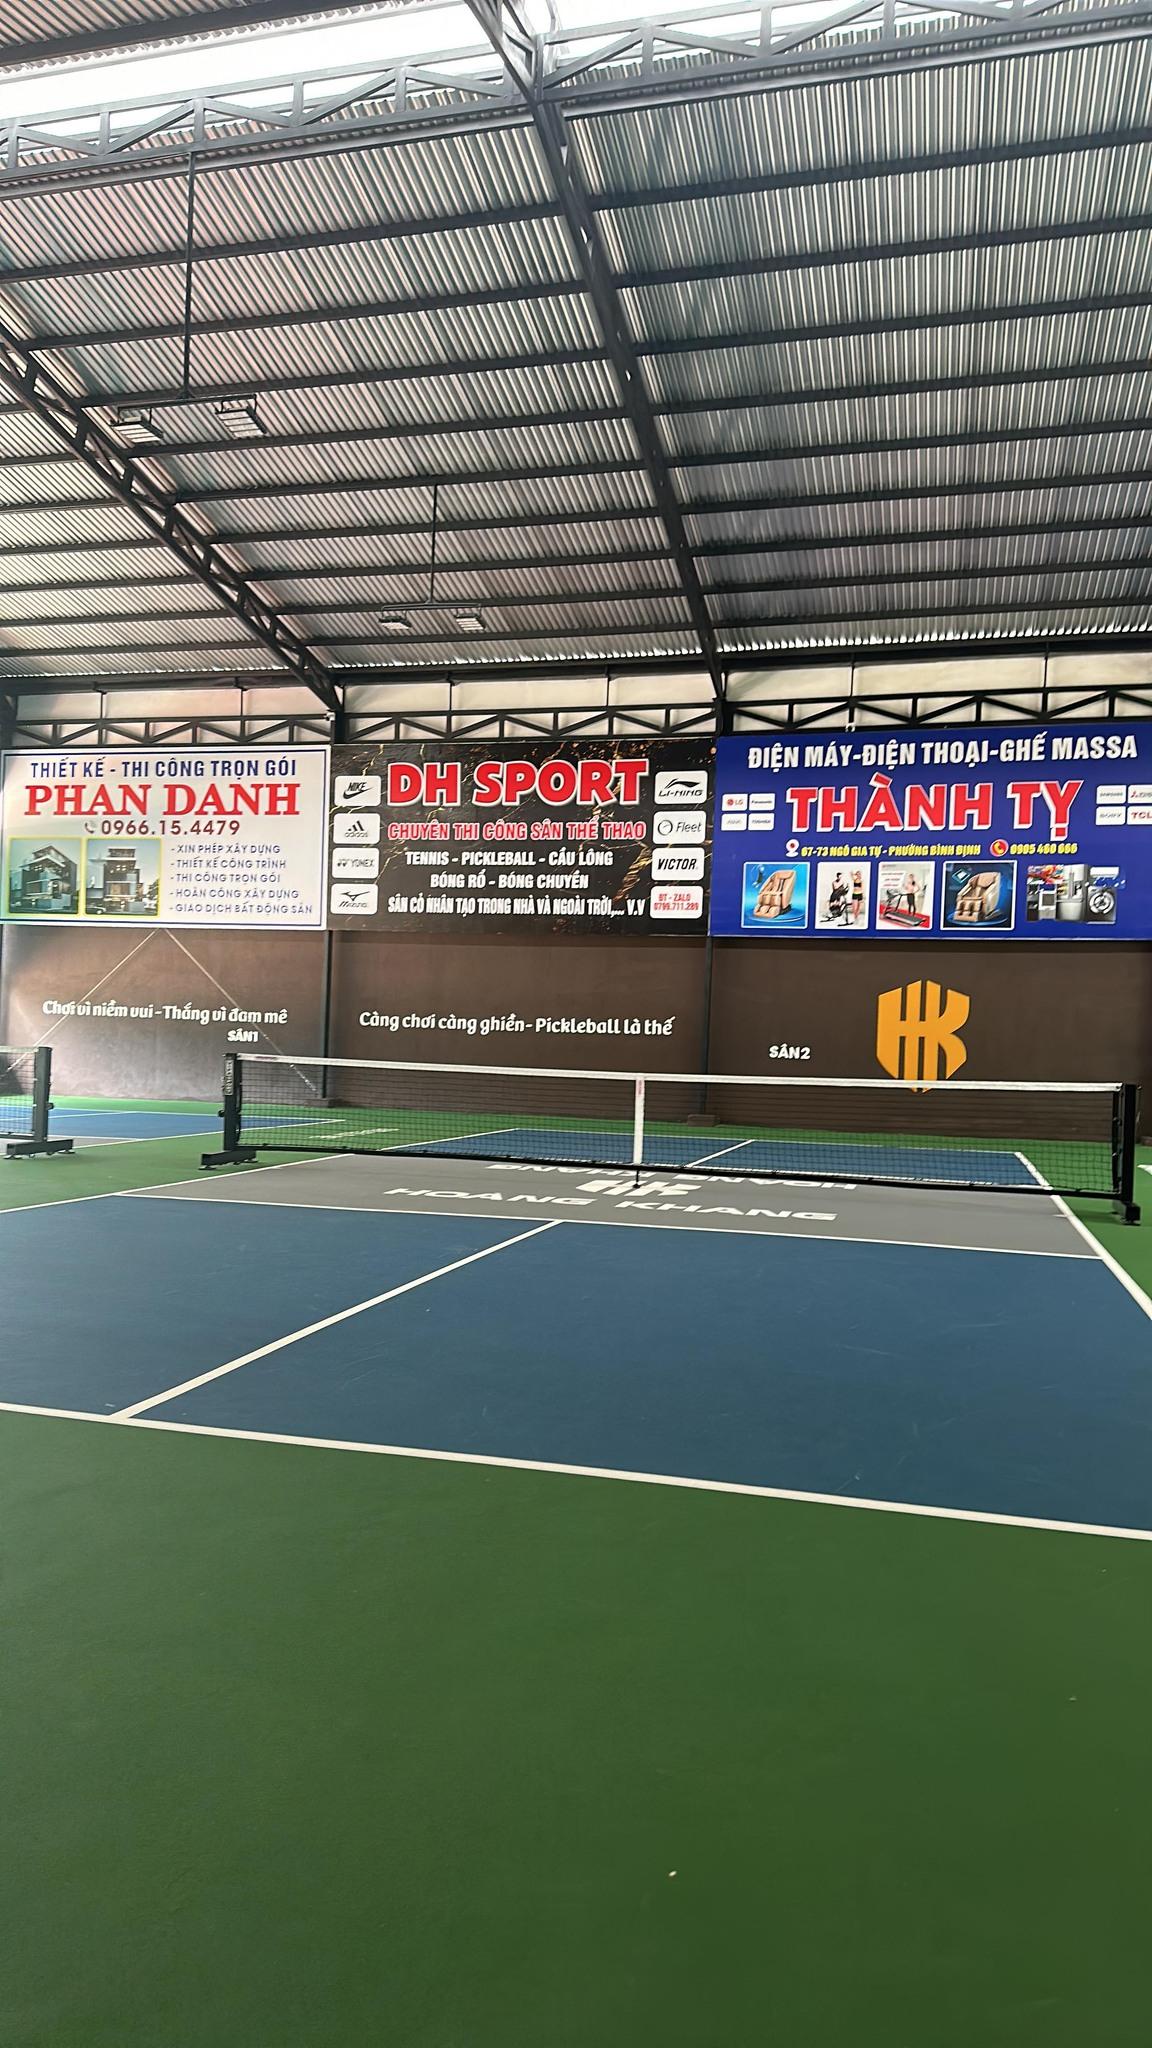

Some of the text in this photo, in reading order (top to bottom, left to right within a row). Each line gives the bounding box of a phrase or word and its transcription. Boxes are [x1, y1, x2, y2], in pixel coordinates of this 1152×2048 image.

[748, 742, 799, 772] ĐIỆN
[1051, 735, 1138, 760] MASSA
[31, 757, 77, 777] THIẾT
[84, 757, 106, 777] KẾ
[122, 761, 149, 777] THI
[155, 757, 204, 777] CÔNG
[211, 760, 258, 780] TRỌN
[266, 756, 296, 776] GÓI
[347, 782, 367, 791] NIKE
[387, 759, 649, 806] DH SPORT
[24, 783, 300, 815] PHAN DANH
[786, 771, 1084, 841] THÀNH TỴ
[102, 820, 240, 835] 0966.15.4479
[387, 819, 450, 840] CHUYÊN
[453, 823, 480, 840] THI
[483, 819, 527, 840] CÔNG
[530, 818, 563, 840] SÂN
[601, 821, 646, 840] THAO
[676, 822, 702, 833] Fleet
[177, 845, 195, 853] XIN
[405, 851, 449, 865] TENNIS
[461, 851, 536, 866] PICKLEBALL
[578, 848, 614, 866] LÔNG
[657, 858, 697, 870] VICTOR
[430, 871, 465, 888] BÓNG
[498, 871, 534, 888] BÓNG
[388, 893, 408, 913] SÂN
[409, 892, 425, 913] CỎ
[426, 894, 454, 913] NHÂN
[455, 897, 475, 918] TẠO
[477, 897, 511, 914] TRONG
[513, 894, 535, 915] NHÀ
[537, 894, 551, 915] VÀ
[552, 894, 585, 915] NGOÀI
[42, 1000, 75, 1016] Chơi
[77, 1001, 91, 1016] vì
[93, 1000, 128, 1017] niềm
[212, 1006, 226, 1021] vì
[228, 1007, 262, 1022] đam
[264, 1008, 288, 1024] mê
[359, 1011, 399, 1031] Càng
[401, 1013, 436, 1029] chơi
[438, 1014, 477, 1035] càng
[535, 1017, 621, 1035] Pickleball
[623, 1017, 641, 1035] là
[644, 1016, 676, 1036] thế
[614, 1200, 838, 1221] KHANG
